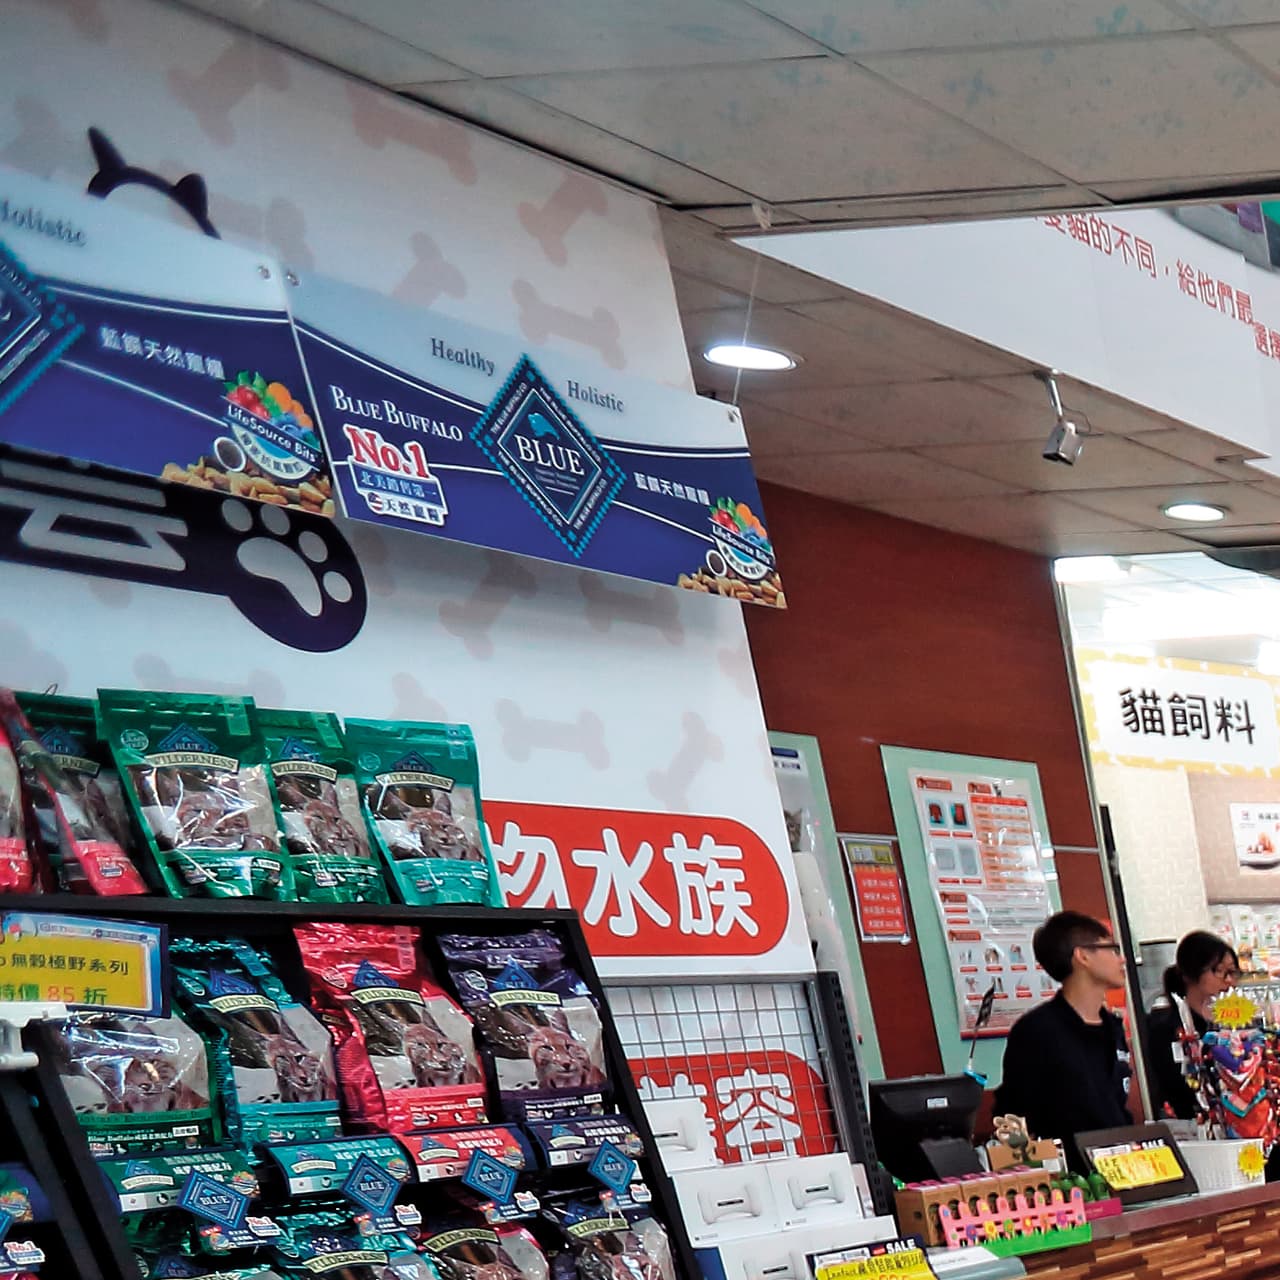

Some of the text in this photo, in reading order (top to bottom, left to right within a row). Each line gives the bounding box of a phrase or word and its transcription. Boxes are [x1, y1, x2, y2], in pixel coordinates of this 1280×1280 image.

[0, 200, 87, 247] olistic
[430, 337, 496, 377] Healthy
[330, 385, 464, 442] BLUE BUFFALO
[567, 380, 625, 413] Holistic
[227, 403, 317, 464] LifeSource Bits
[346, 427, 430, 479] No.1
[513, 434, 586, 476] BLUE
[1119, 686, 1258, 746] 貓飼料
[152, 751, 237, 770] WILDERNESS
[47, 985, 76, 1002] 85
[83, 986, 109, 1005] 折
[360, 1181, 385, 1192] BLUE
[479, 1171, 503, 1183] BLUE
[200, 1195, 231, 1206] BLUE
[885, 1238, 918, 1255] SALE
